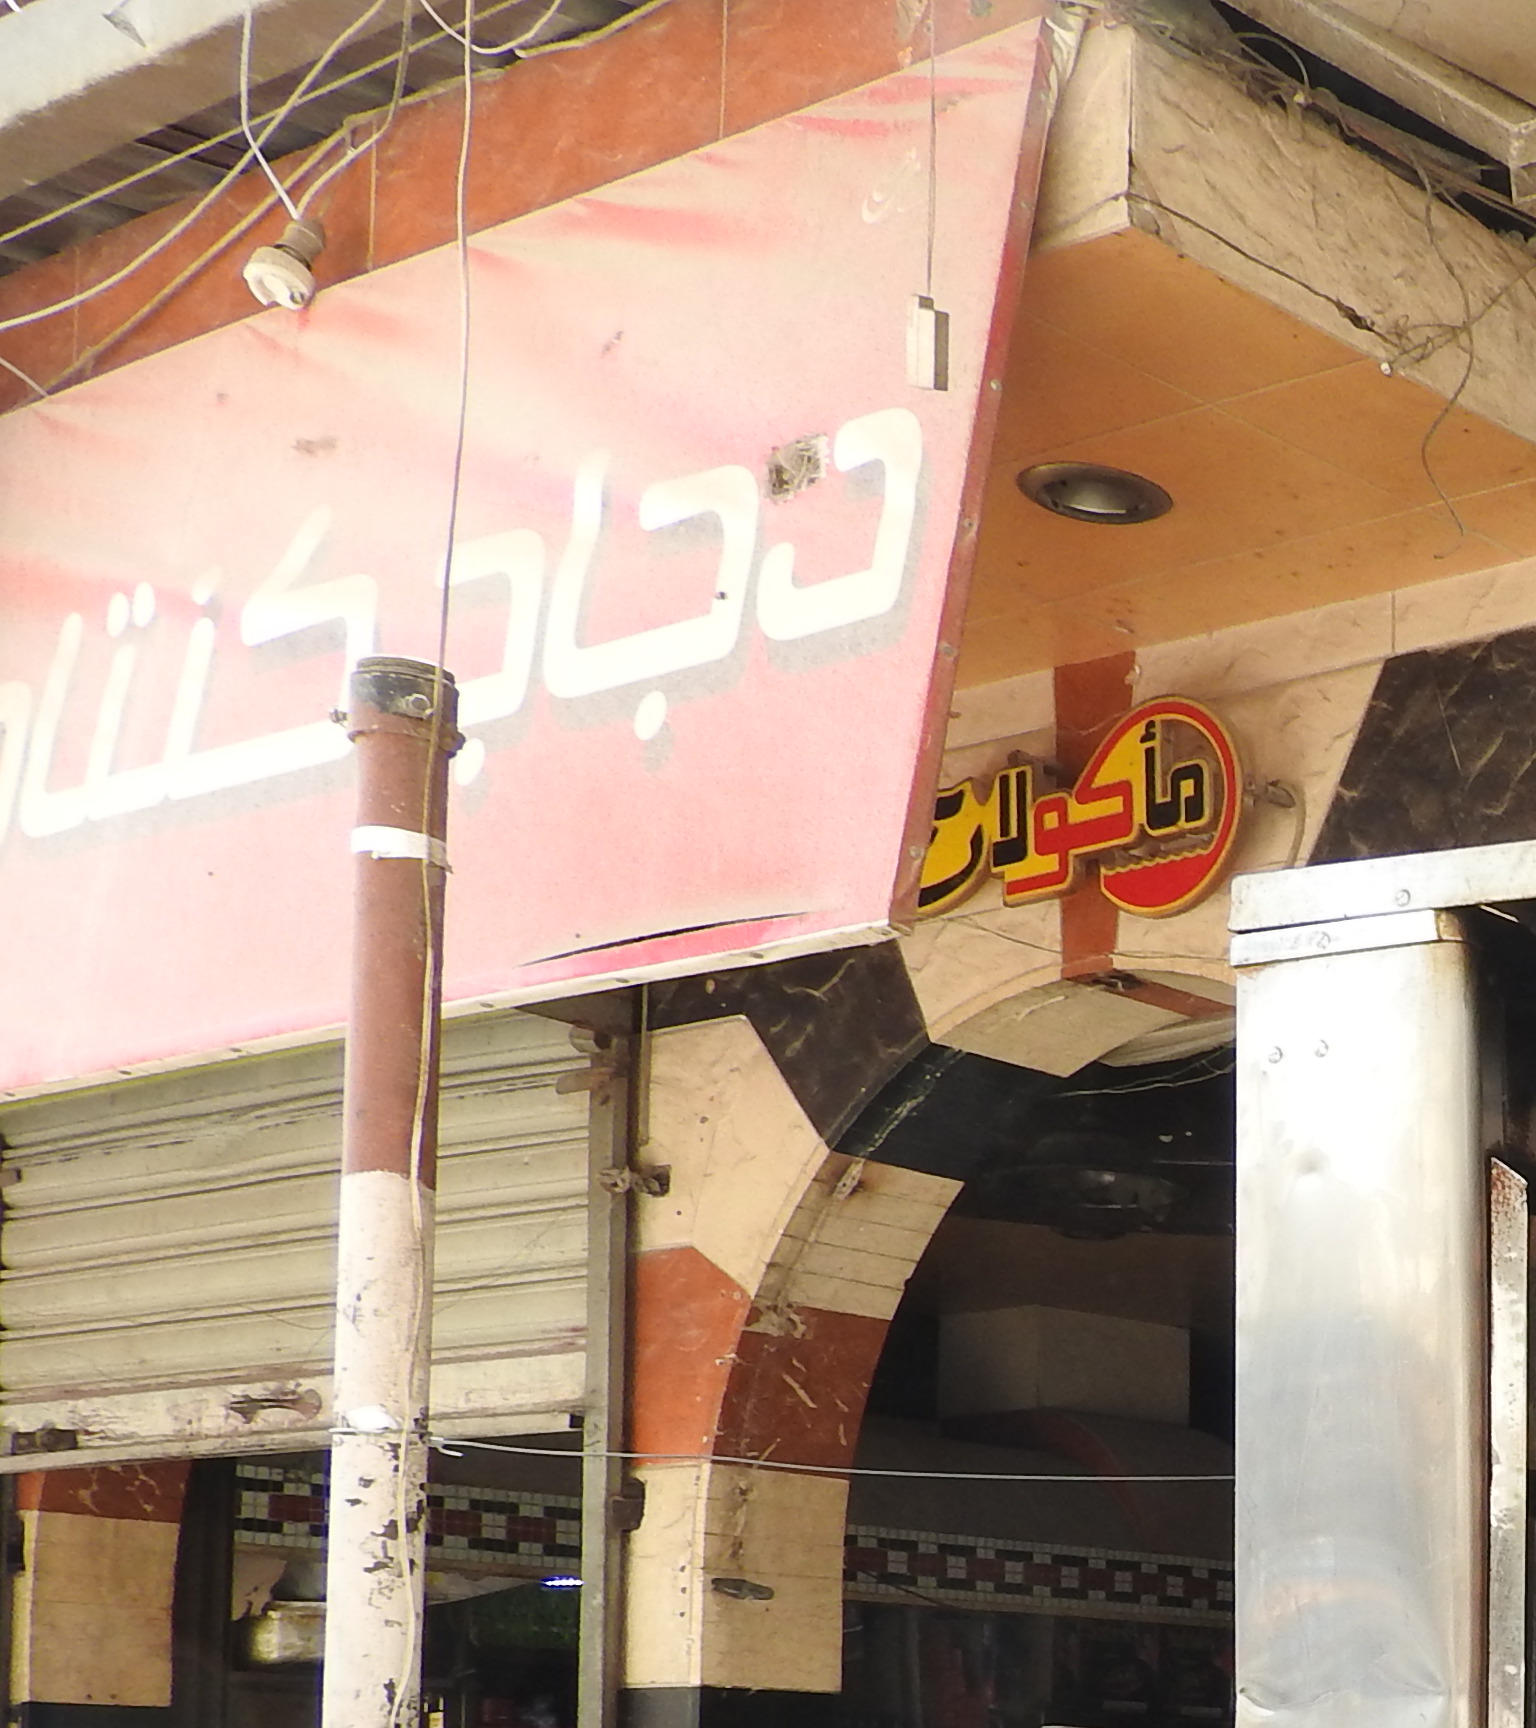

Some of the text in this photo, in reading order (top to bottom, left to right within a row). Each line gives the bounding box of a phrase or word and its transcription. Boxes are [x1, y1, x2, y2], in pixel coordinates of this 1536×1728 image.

[0, 407, 922, 842] دجاج كنتا
[916, 718, 1206, 908] مأكولات
